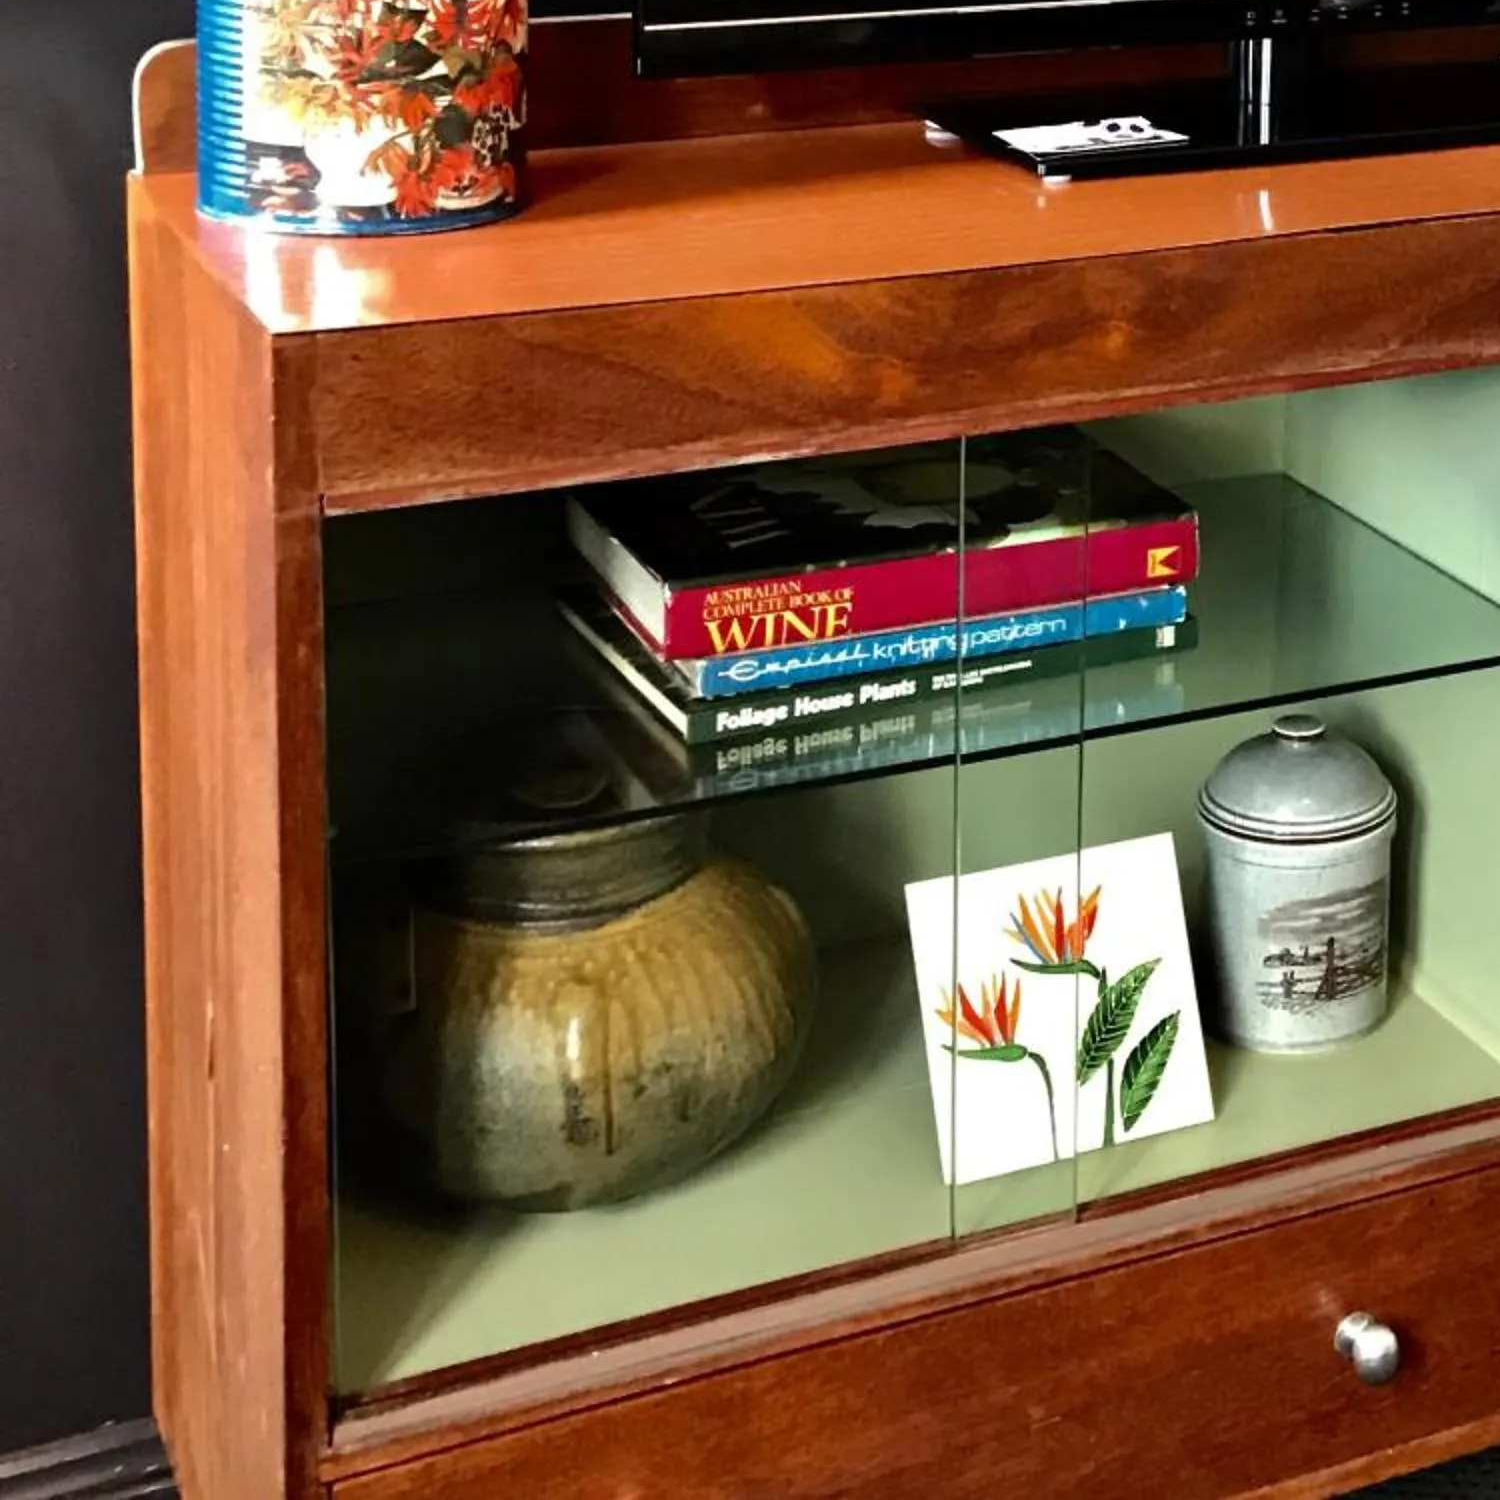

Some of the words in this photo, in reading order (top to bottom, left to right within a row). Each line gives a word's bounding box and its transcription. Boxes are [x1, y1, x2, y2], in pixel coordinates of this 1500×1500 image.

[703, 597, 784, 621] COMPLETE
[789, 590, 832, 609] BOOK
[834, 586, 855, 604] OF
[704, 580, 802, 606] AUSTRALIAN
[704, 602, 853, 653] WINE
[971, 617, 1067, 648] pattern
[716, 704, 789, 733] Foliage
[794, 691, 855, 717] House
[859, 678, 917, 704] Plants
